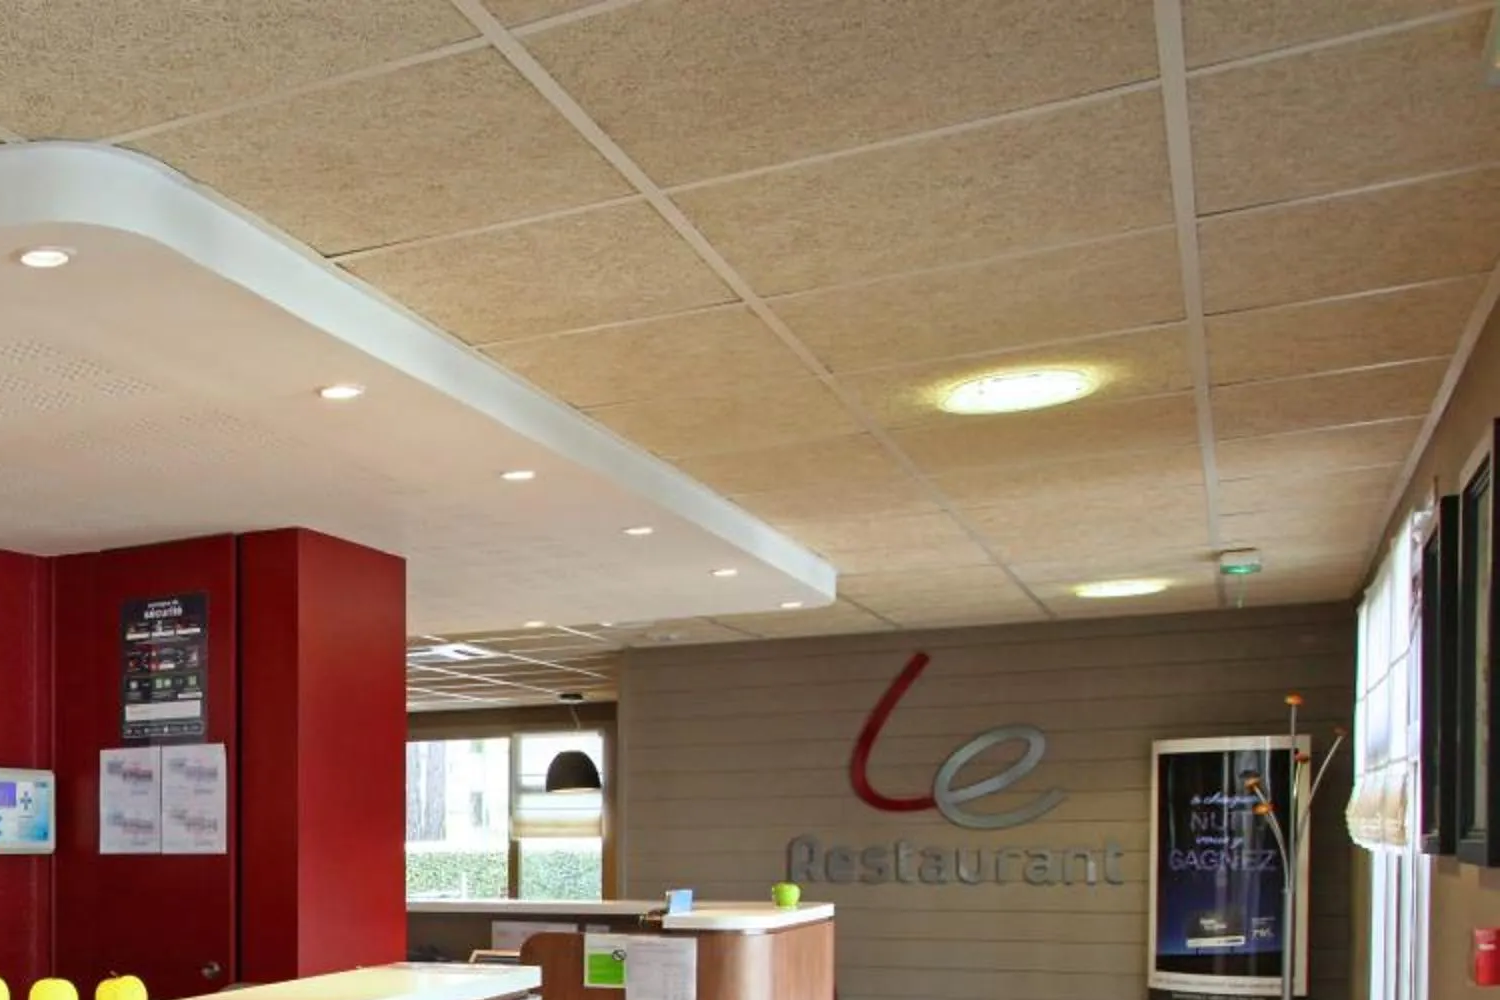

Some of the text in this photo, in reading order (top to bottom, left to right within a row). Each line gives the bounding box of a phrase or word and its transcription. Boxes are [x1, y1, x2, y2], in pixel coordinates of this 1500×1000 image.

[850, 651, 1067, 830] Le
[786, 834, 1125, 886] Restaurant
[1169, 848, 1277, 871] GAGNEZ
